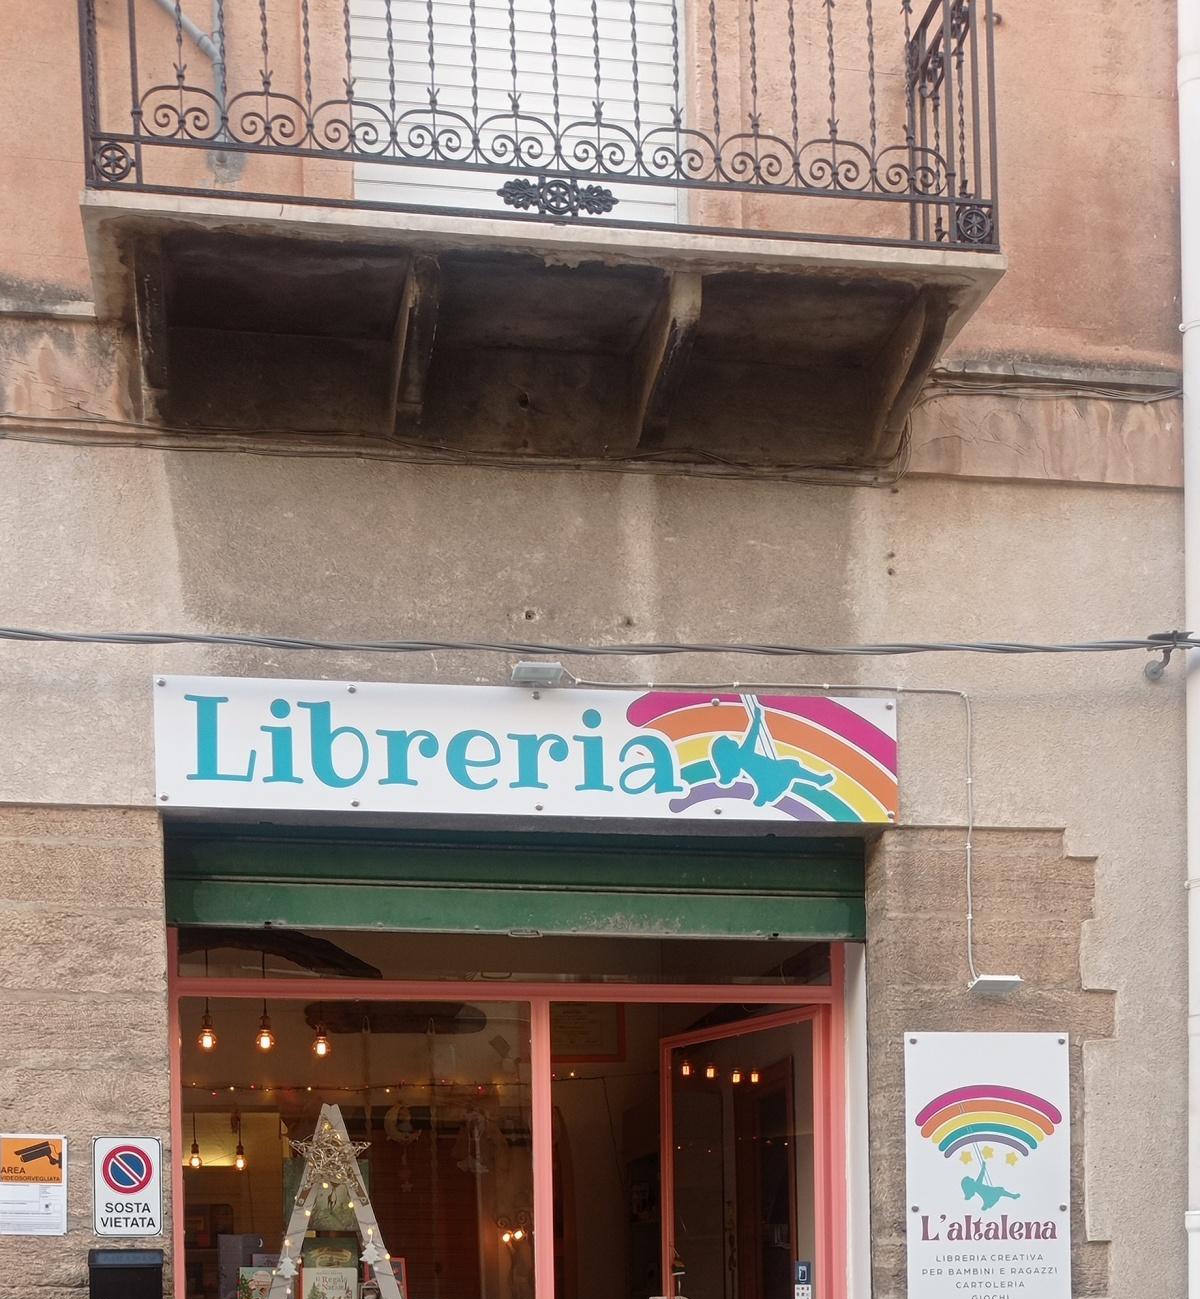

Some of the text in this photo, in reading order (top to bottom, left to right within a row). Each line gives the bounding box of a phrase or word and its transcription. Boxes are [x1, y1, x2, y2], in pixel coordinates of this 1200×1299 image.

[184, 693, 687, 796] Libreria
[0, 1166, 26, 1174] AREA
[105, 1202, 151, 1213] SOSTA
[101, 1217, 156, 1228] VIETATA
[921, 1214, 1057, 1241] L'altalena
[936, 1253, 1044, 1263] LIBRERIA CREATIVA
[922, 1266, 1058, 1276] PER BAMBINI E RAGAZZI
[955, 1281, 1025, 1289] CARTOLERIA
